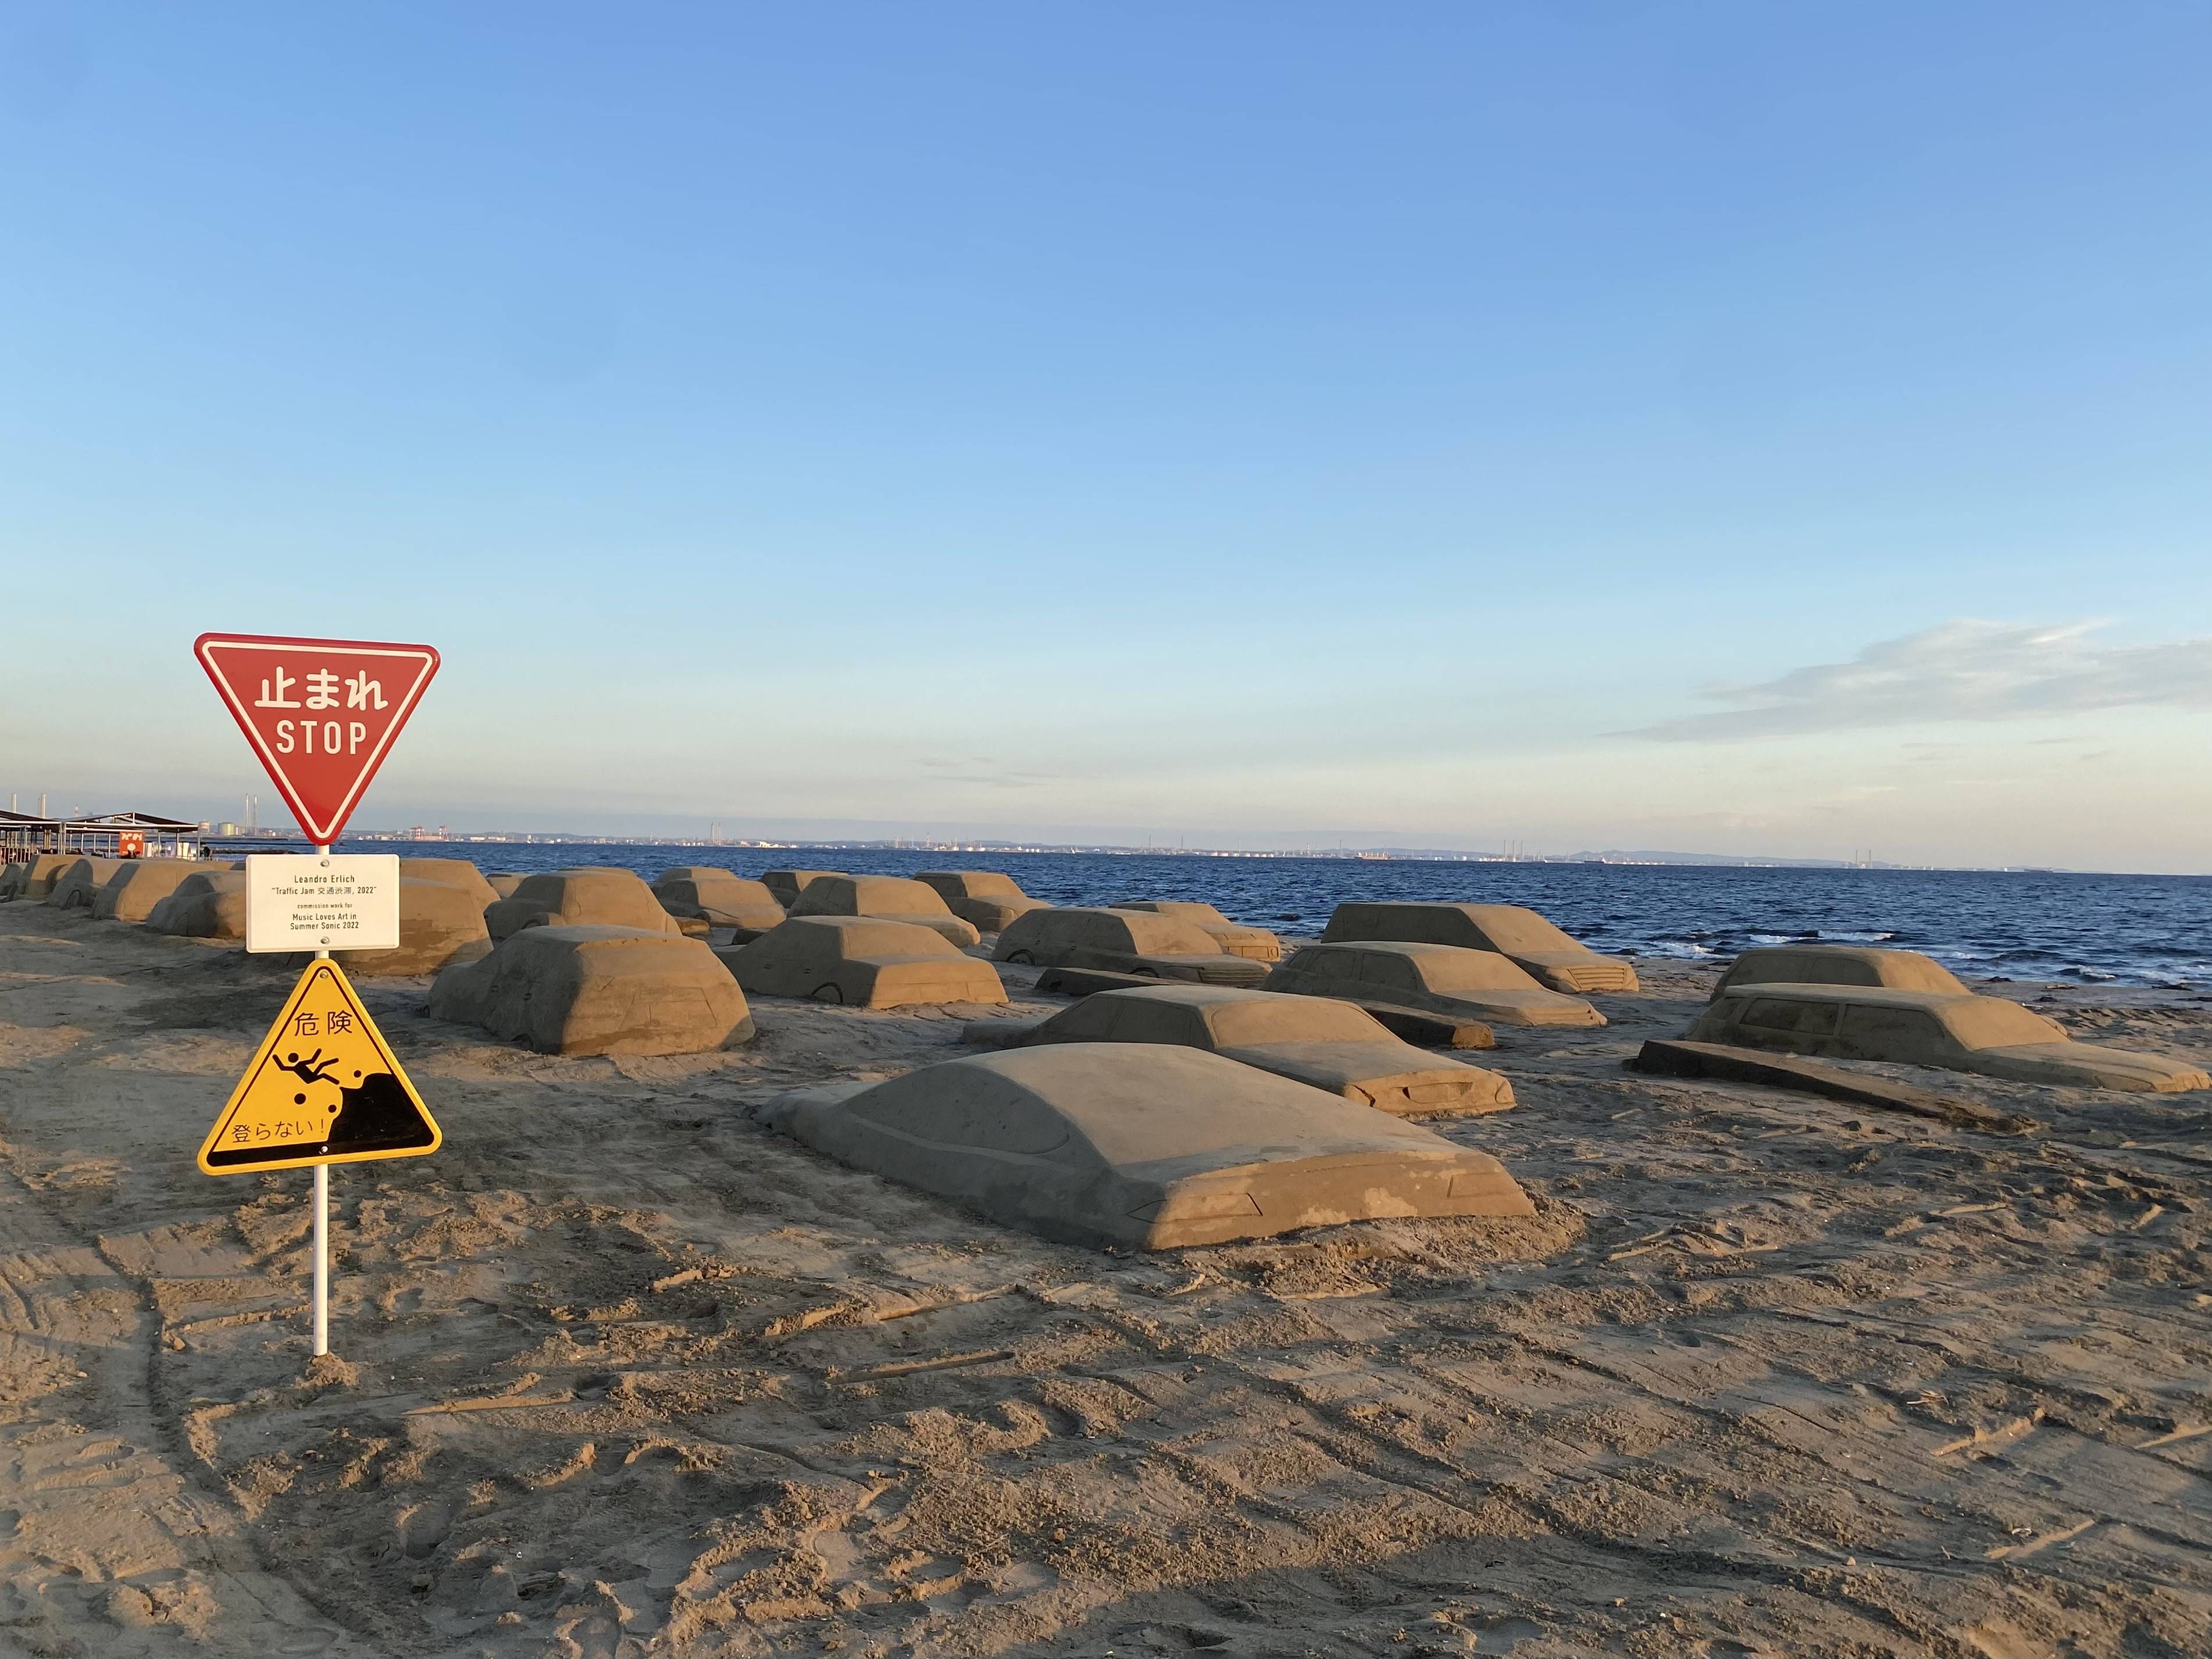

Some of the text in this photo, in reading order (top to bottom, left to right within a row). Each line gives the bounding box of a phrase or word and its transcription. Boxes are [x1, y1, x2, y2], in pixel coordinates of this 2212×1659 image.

[254, 666, 388, 711] 止まれ
[276, 719, 366, 754] STOP
[294, 875, 355, 883] Leandro Erlich
[294, 1009, 353, 1037] 危険
